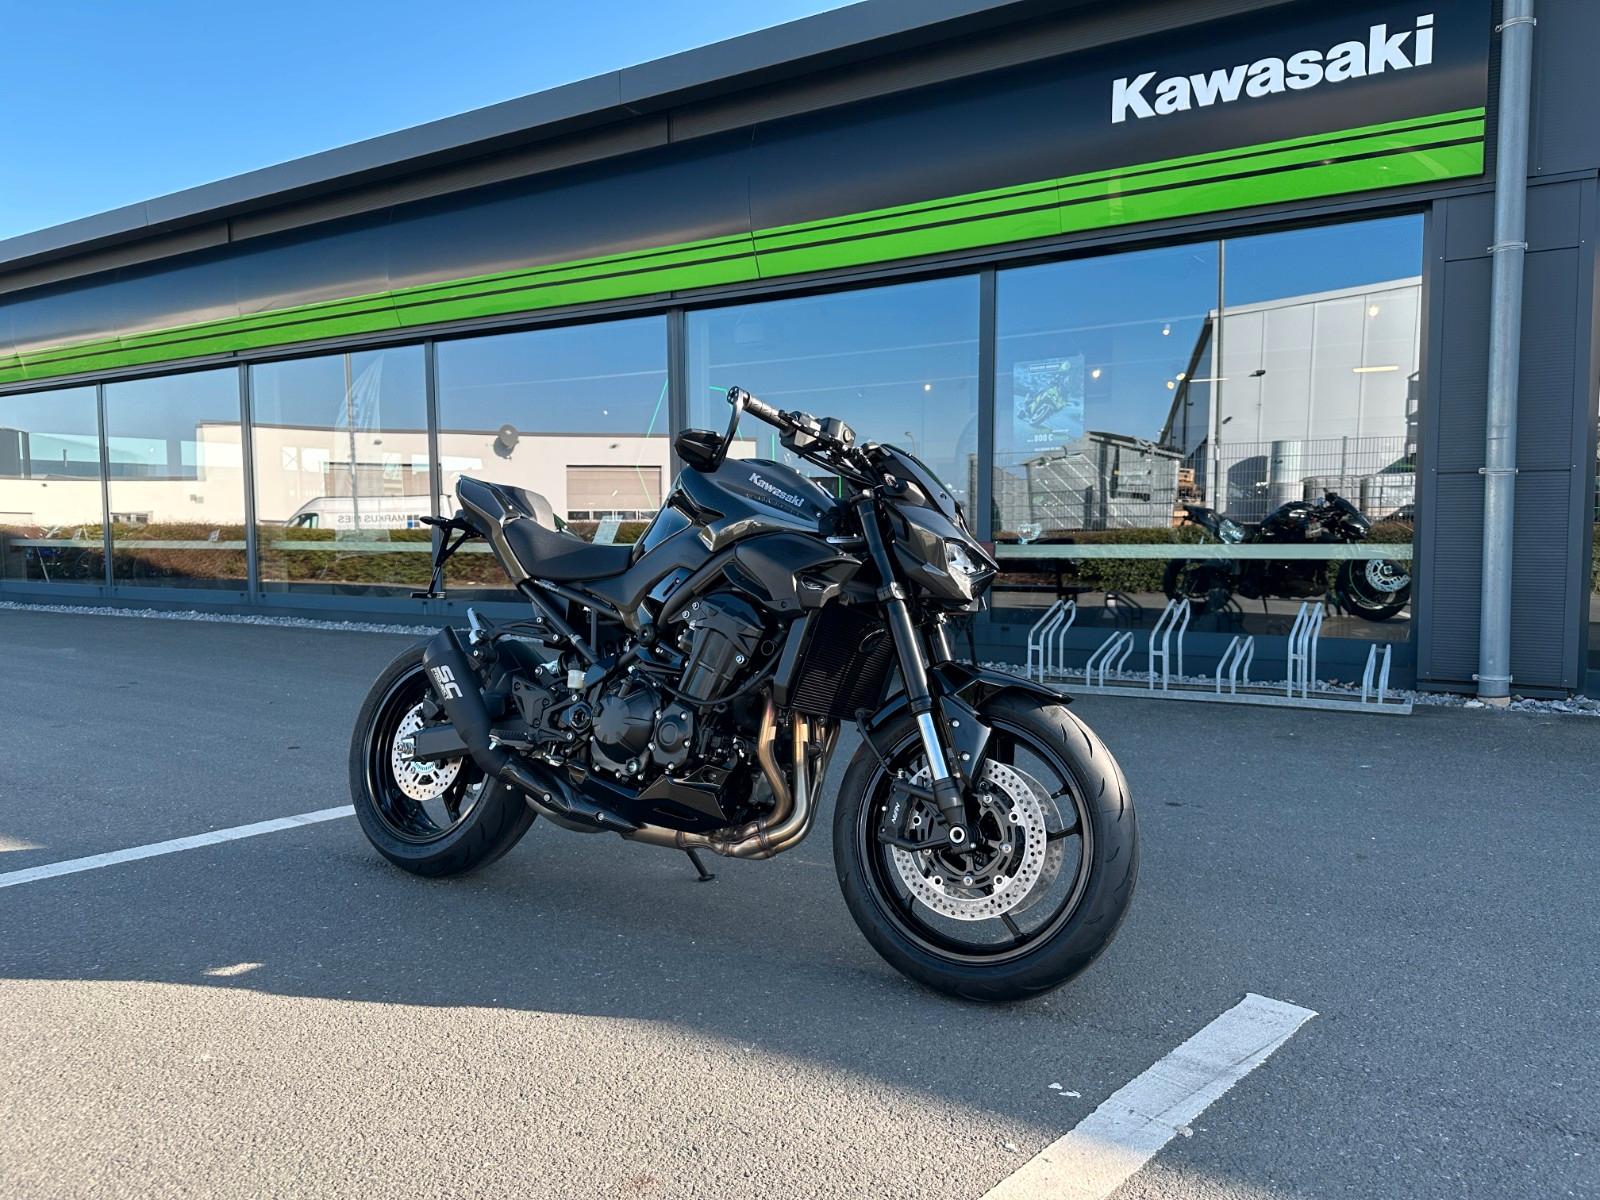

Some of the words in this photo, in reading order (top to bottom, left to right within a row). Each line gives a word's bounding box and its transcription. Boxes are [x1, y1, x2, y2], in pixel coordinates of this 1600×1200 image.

[1112, 13, 1434, 123] Kawasaki
[748, 473, 805, 507] Kawasaki
[437, 664, 463, 699] SC
